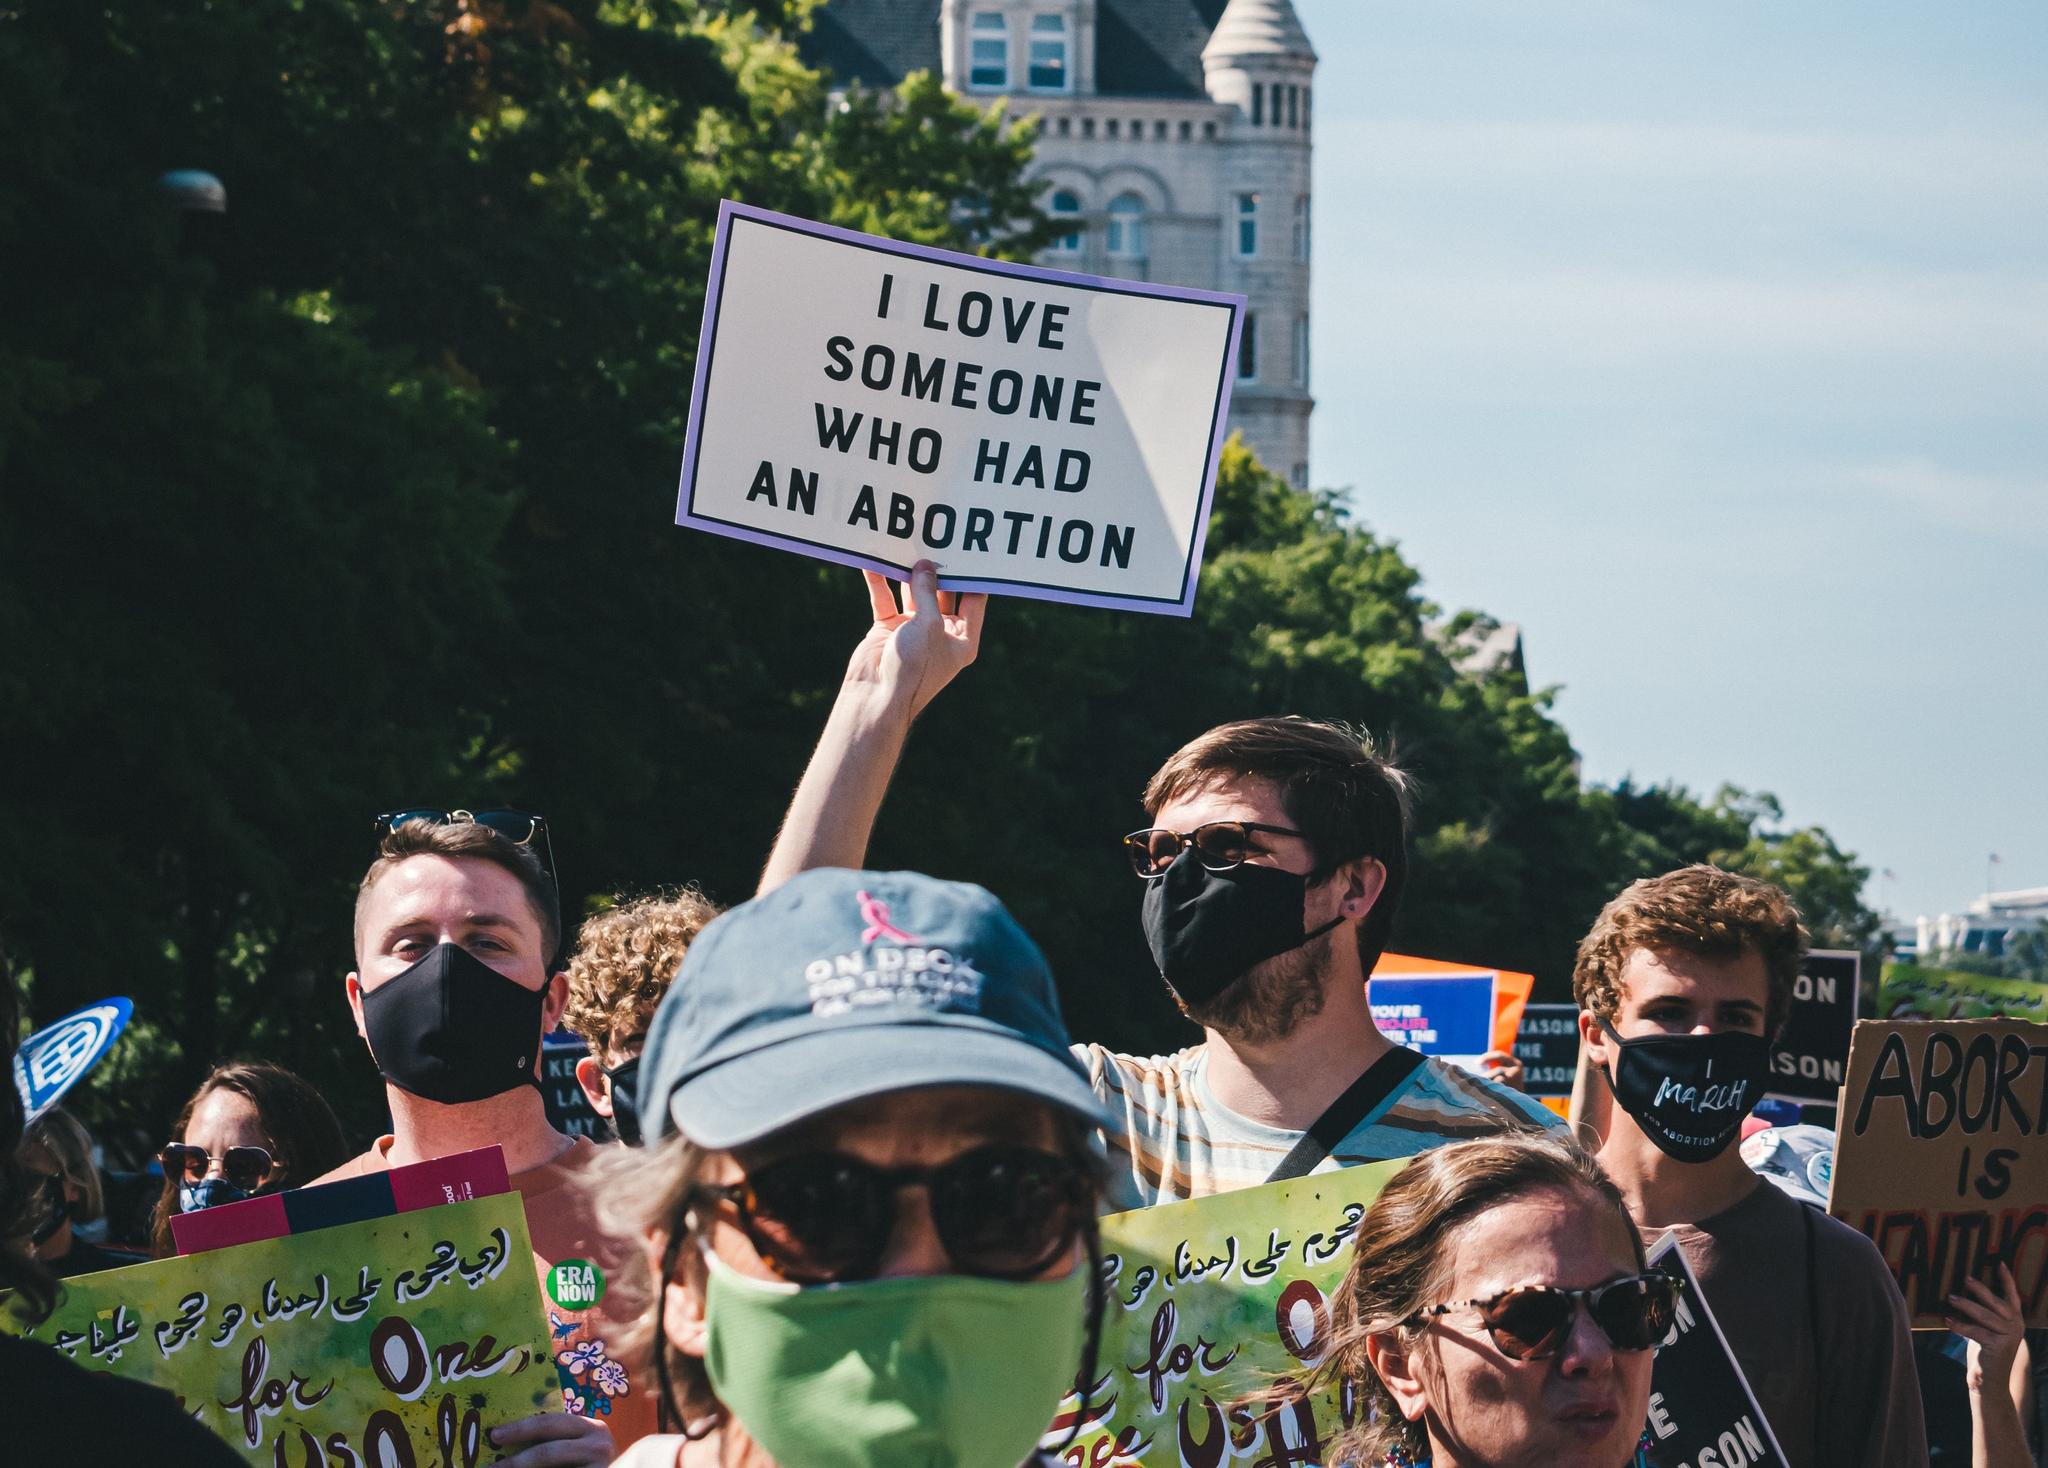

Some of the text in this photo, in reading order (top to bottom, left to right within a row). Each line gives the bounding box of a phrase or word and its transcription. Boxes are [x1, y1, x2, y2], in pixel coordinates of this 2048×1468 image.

[877, 273, 1070, 350] I LOVE
[823, 335, 1101, 425] SOMEONE
[814, 402, 1091, 493] WHO HAD
[746, 460, 1136, 569] AN ABORTION
[1769, 1051, 1841, 1083] SON
[1663, 1127, 1716, 1146] ABORTION
[1957, 1146, 2021, 1200] IS
[556, 1266, 596, 1285] ERA
[557, 1284, 596, 1302] NOW
[1126, 1298, 1240, 1414] for
[218, 1334, 335, 1448] for
[1677, 1415, 1766, 1468] SON
